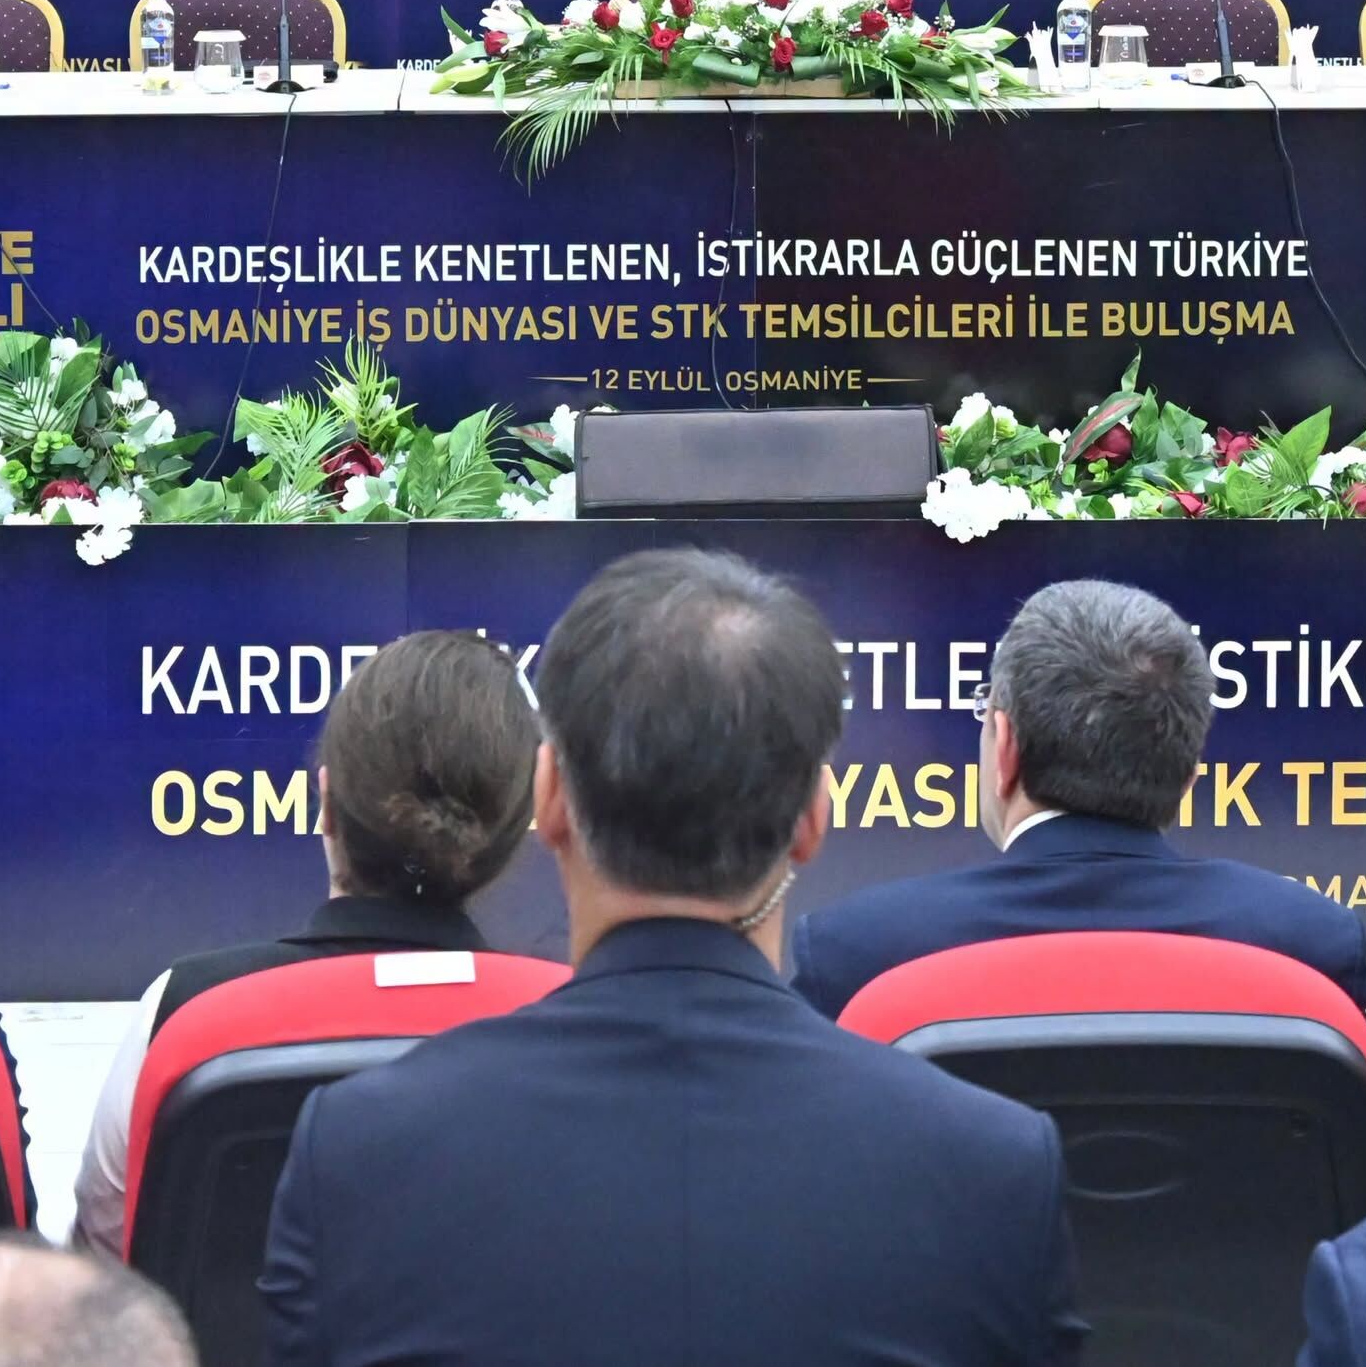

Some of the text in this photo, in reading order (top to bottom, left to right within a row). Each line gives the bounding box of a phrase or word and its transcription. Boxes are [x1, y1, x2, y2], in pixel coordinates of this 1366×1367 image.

[139, 230, 1309, 293] KARDEŞLİKLE KENETLENEN, İSTİKRARLA GÜÇLENEN TÜRKİYE
[135, 293, 1295, 353] OSMANİYE İŞ DÜNYASI VE STK TEMSİLCİLERİ İLE BULUŞMA
[591, 366, 862, 392] 12 EYLÜL OSMANİYE
